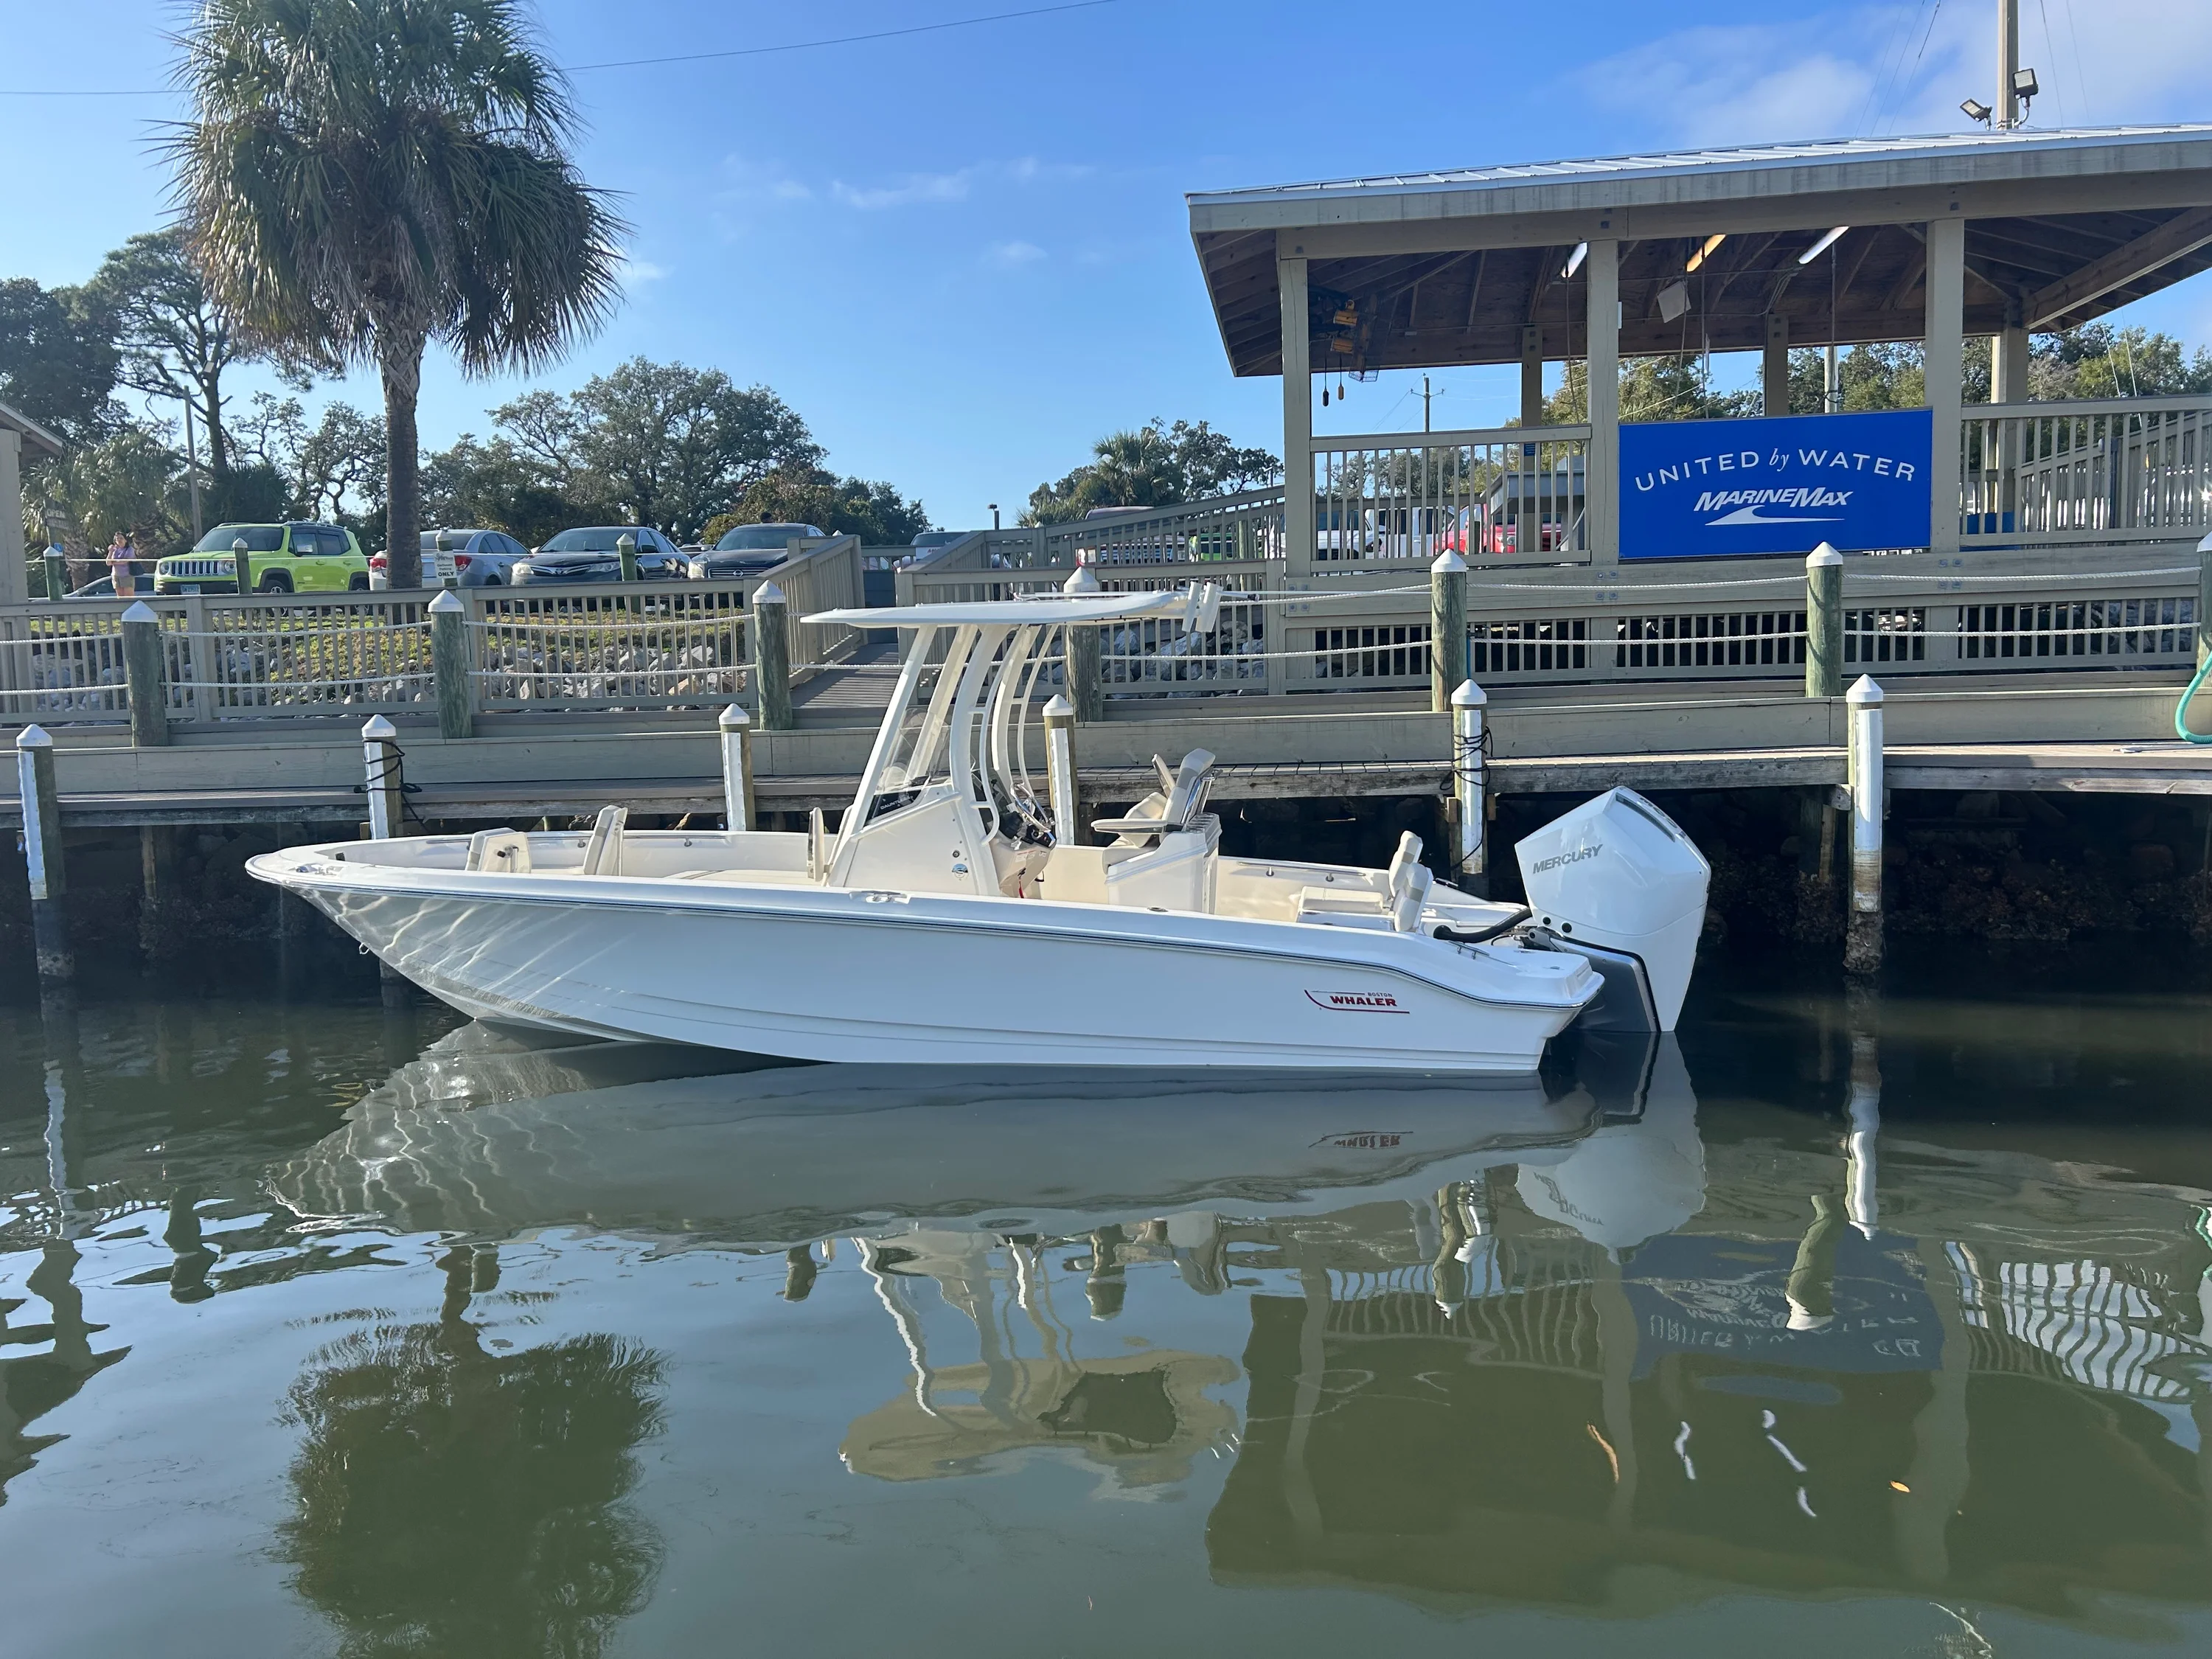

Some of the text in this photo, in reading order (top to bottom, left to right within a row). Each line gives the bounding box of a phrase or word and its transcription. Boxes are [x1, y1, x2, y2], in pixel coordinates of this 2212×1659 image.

[1635, 448, 1916, 491] UNITED by WATER
[46, 509, 66, 518] OPEN
[1532, 844, 1603, 874] MERCURY
[1329, 995, 1397, 1006] WHALER
